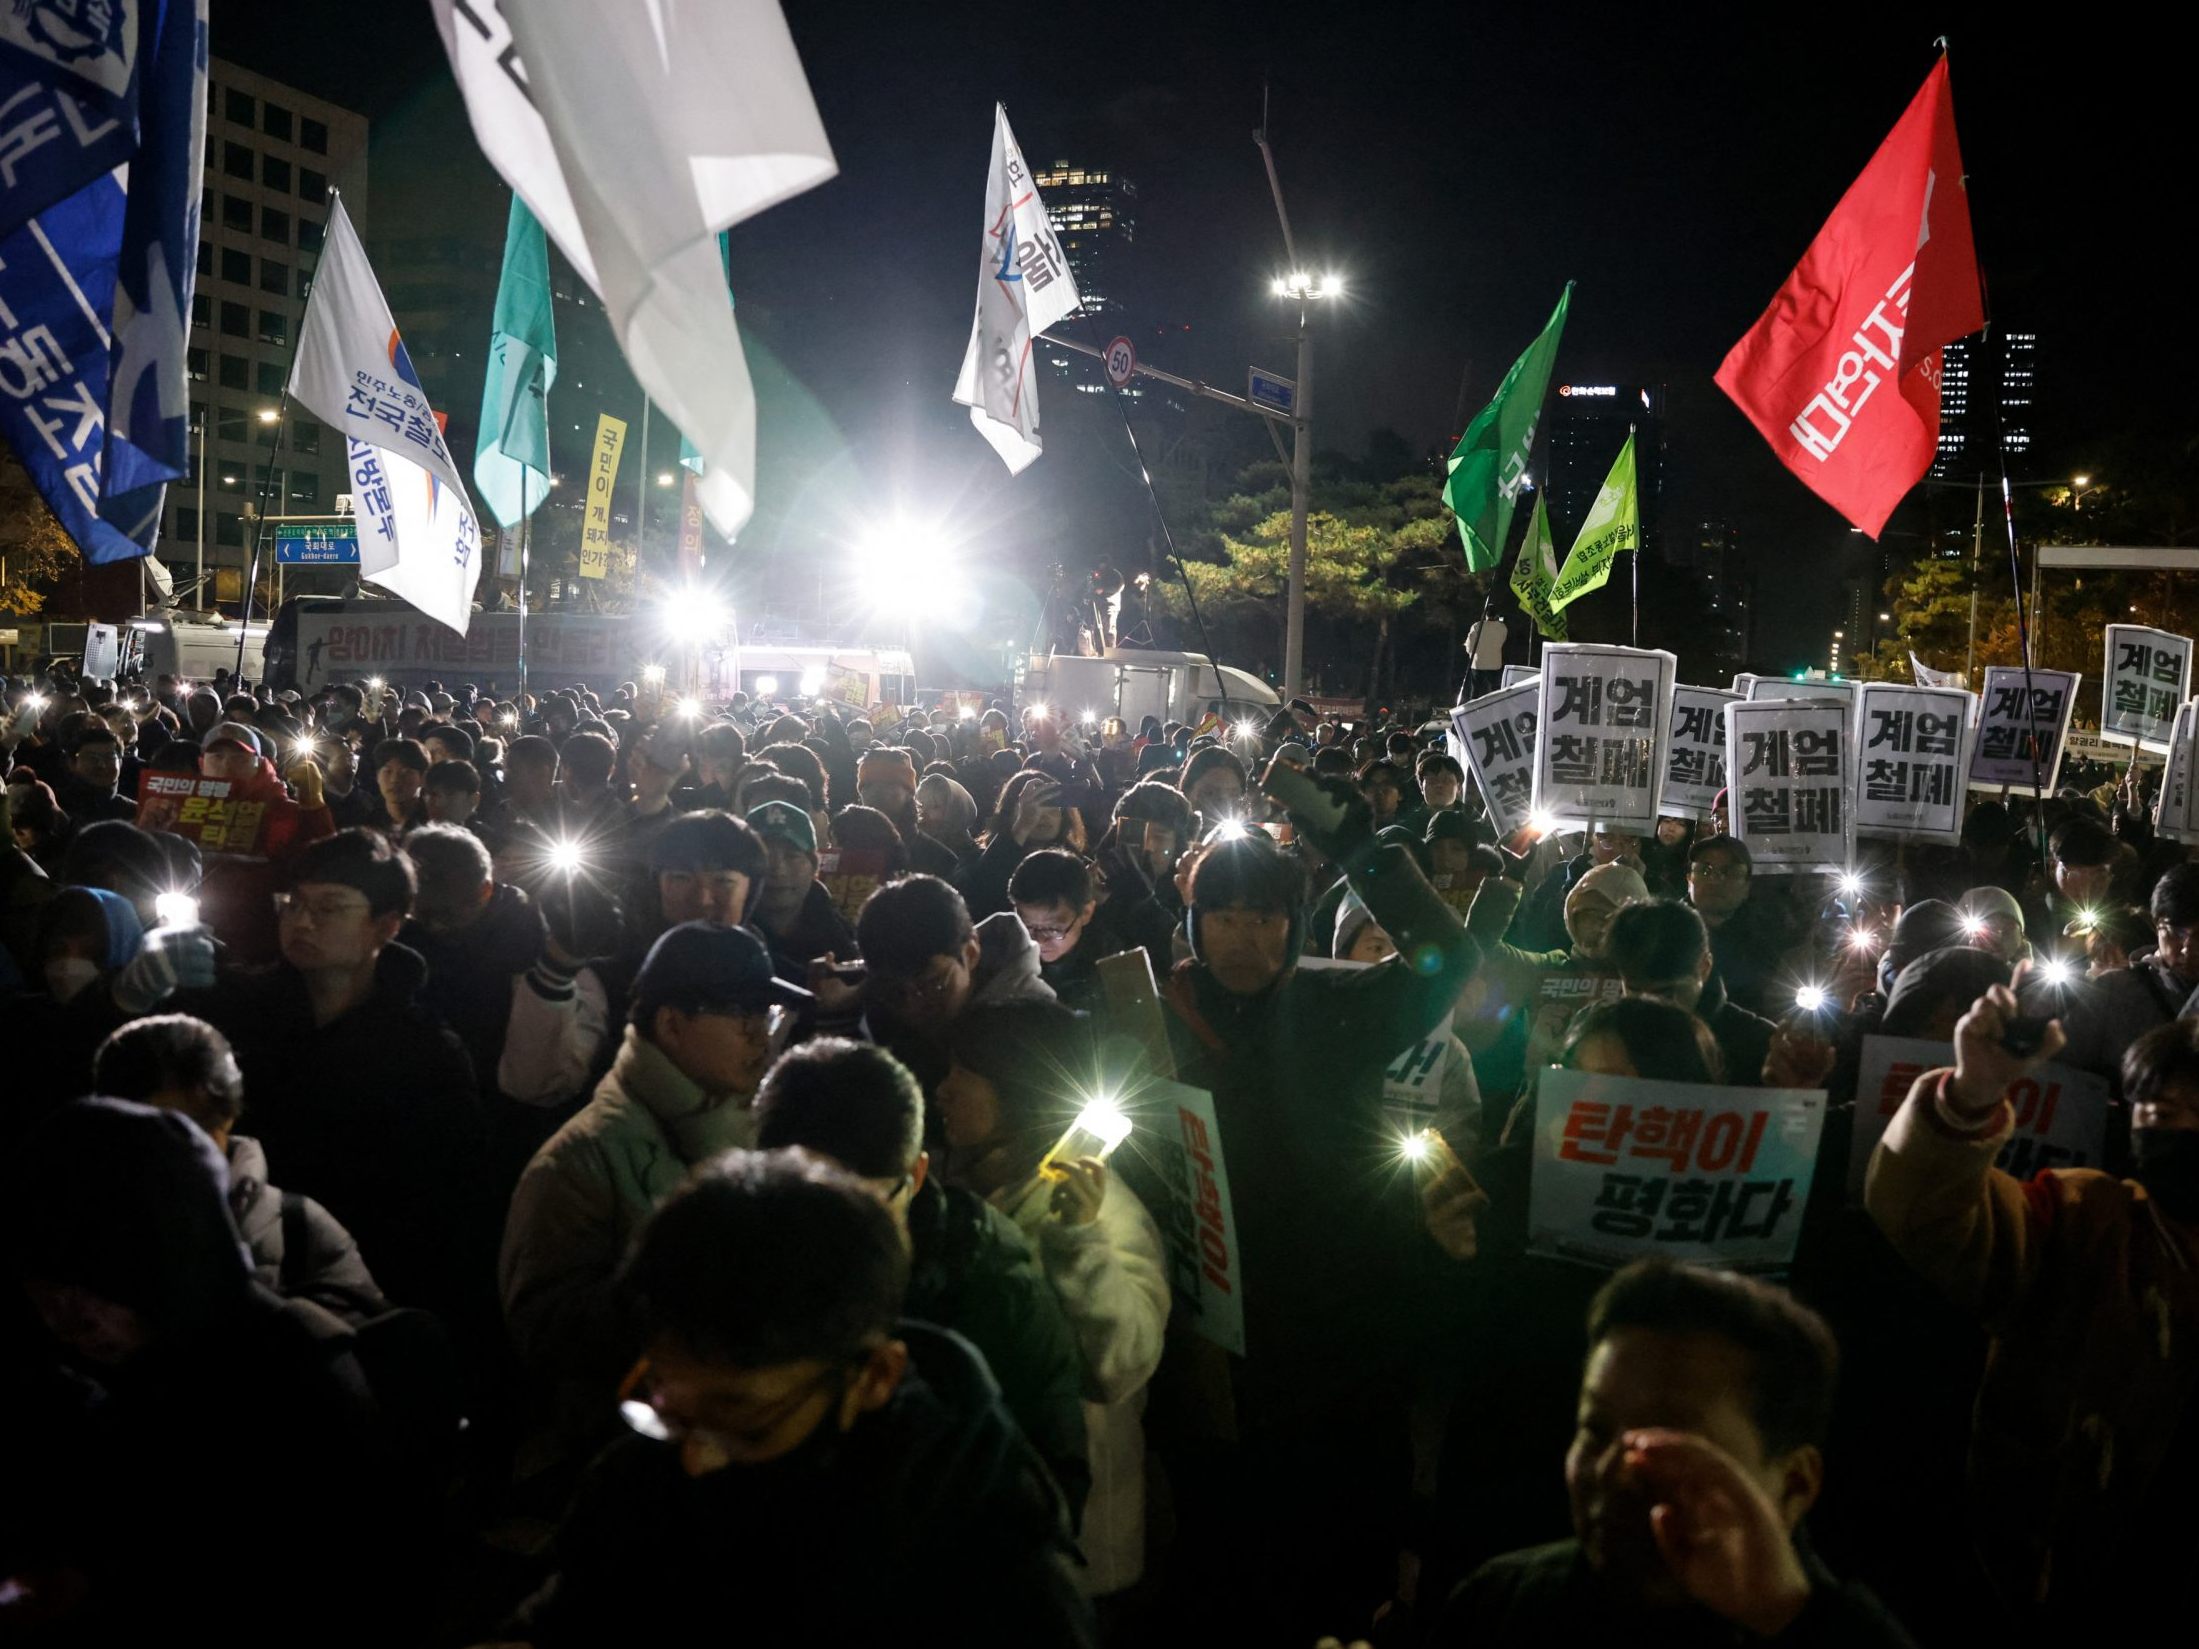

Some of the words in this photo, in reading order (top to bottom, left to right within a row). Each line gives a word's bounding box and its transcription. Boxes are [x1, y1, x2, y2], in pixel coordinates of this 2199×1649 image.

[1112, 350, 1129, 374] 50
[2118, 643, 2182, 686] 계엄
[1553, 676, 1653, 728] 계엄
[1989, 686, 2062, 723] 계엄
[1742, 730, 1839, 777] 계엄
[1868, 710, 1958, 755] 계엄
[1552, 734, 1650, 788] 철폐
[1866, 759, 1954, 806] 철폐
[147, 776, 196, 795] 국민의
[1744, 787, 1840, 835] 철폐
[1560, 1099, 1769, 1173] 탄핵이
[1591, 1172, 1793, 1244] 평화다
